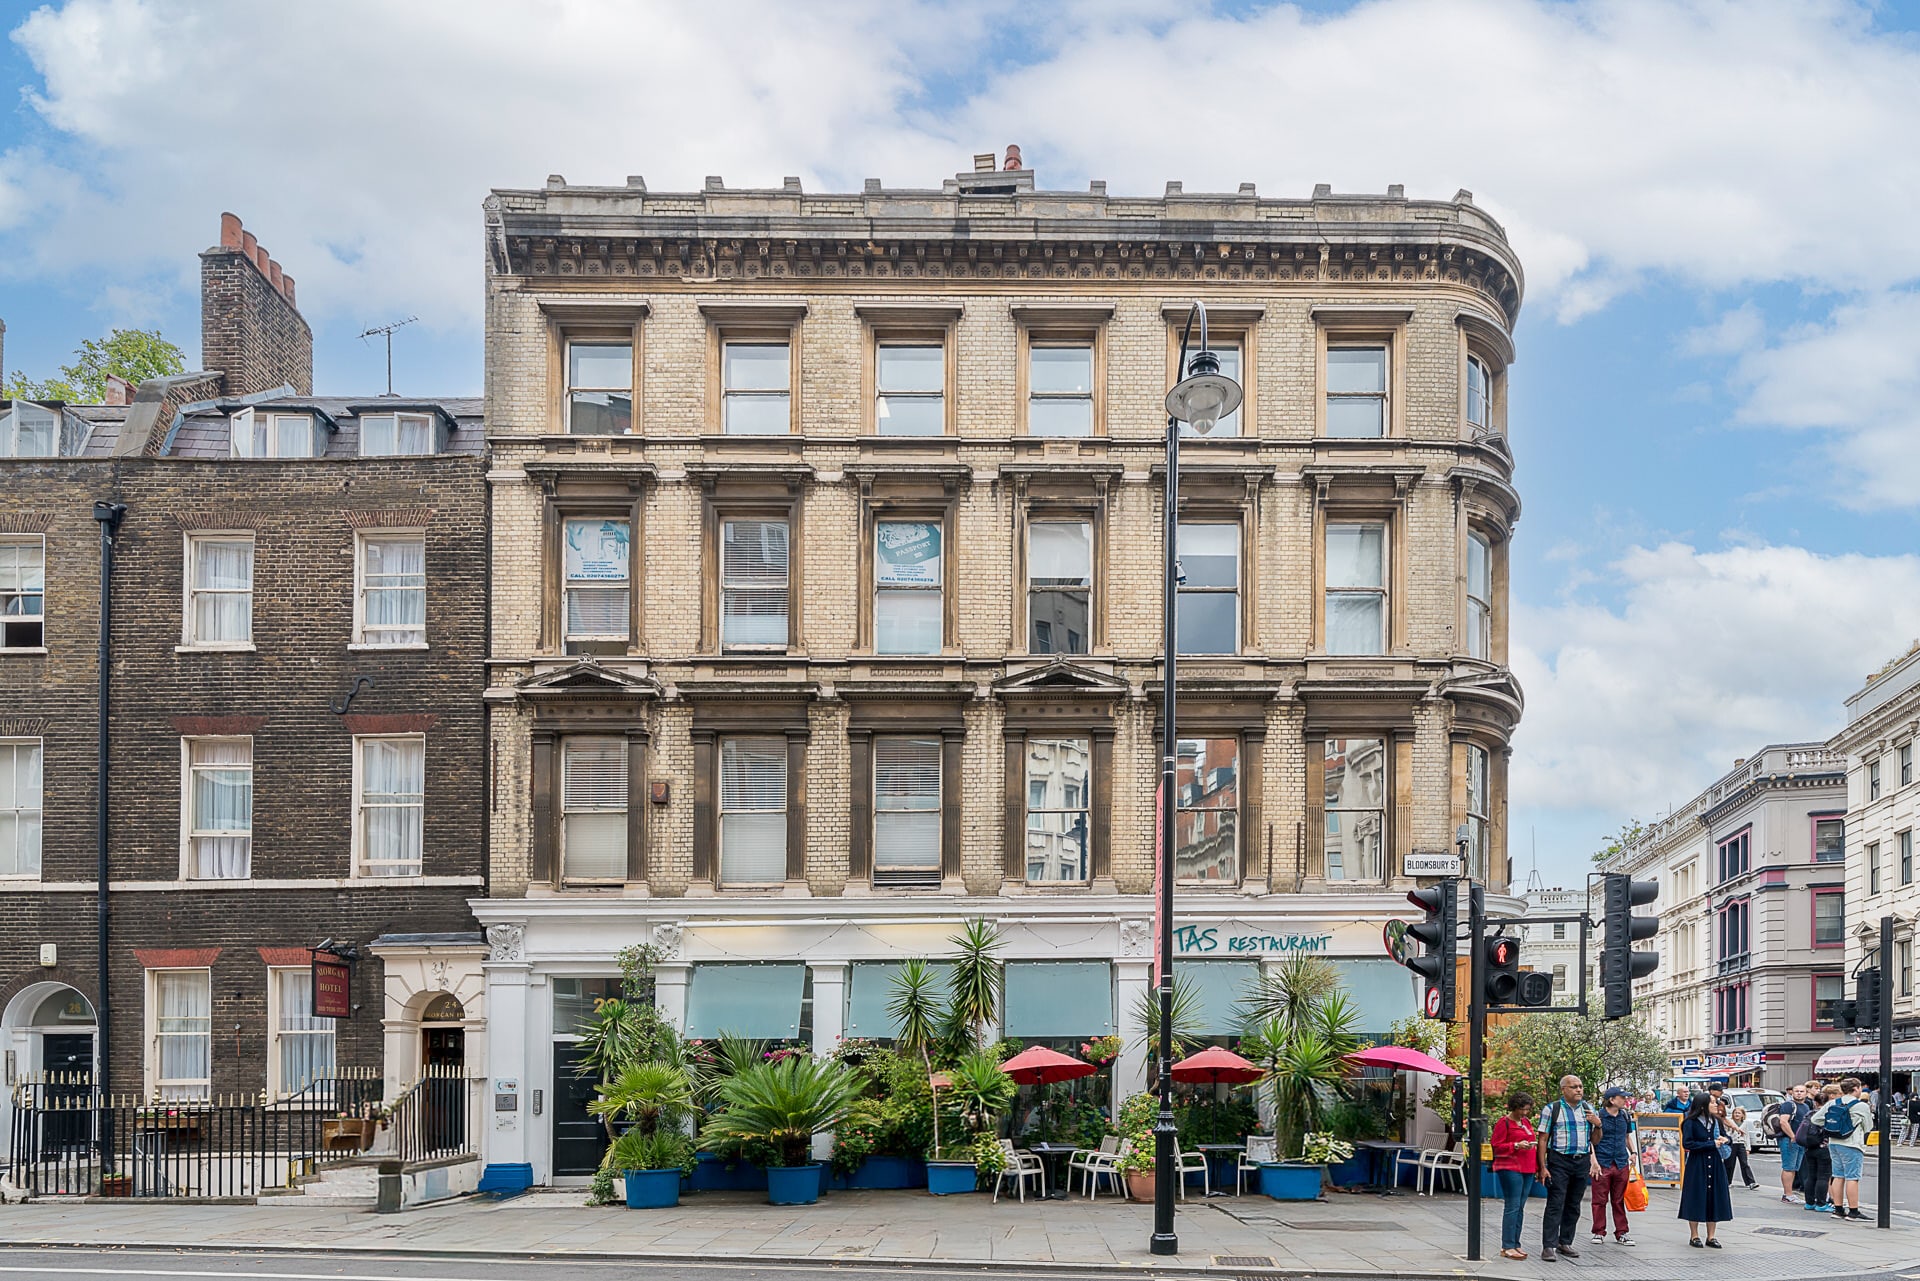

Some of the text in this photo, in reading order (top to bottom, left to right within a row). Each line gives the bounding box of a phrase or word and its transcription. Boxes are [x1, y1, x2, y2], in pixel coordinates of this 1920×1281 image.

[895, 541, 931, 557] PASSPORT
[1407, 860, 1449, 870] BLOOMSBURY
[1173, 925, 1333, 952] TAS RESTAURANT
[317, 967, 345, 979] MORGAN
[320, 983, 343, 993] HOTEL
